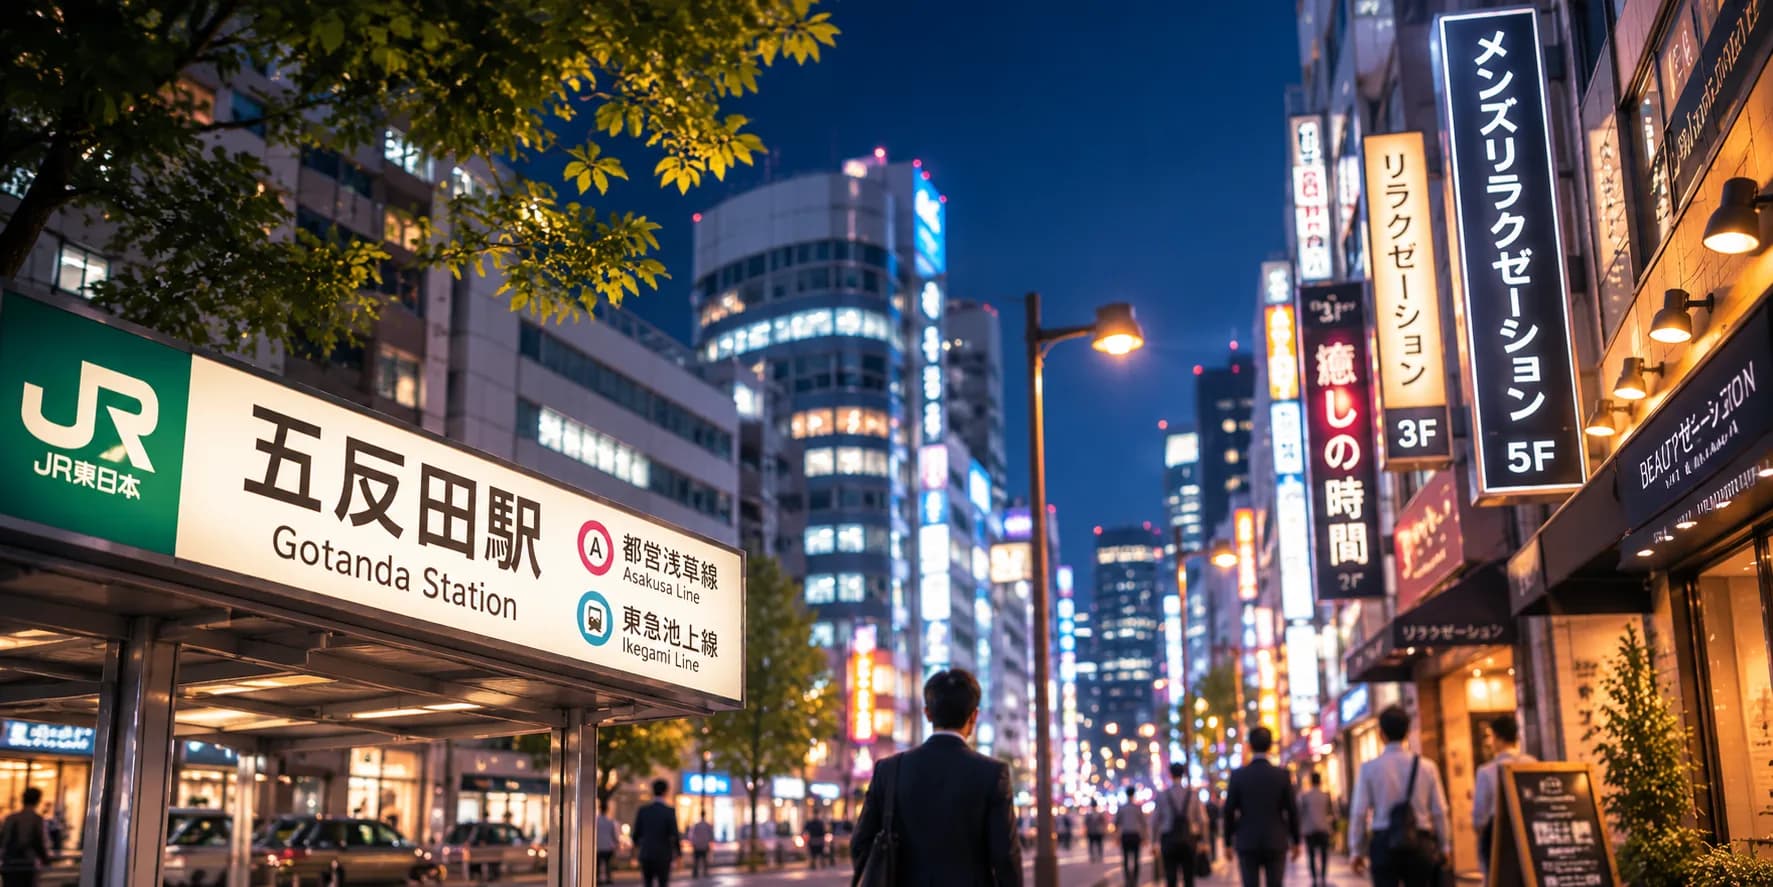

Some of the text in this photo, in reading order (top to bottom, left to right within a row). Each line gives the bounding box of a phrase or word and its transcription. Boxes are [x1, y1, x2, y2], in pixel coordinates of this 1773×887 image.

[1474, 30, 1545, 422] メンズリラクゼーション
[1383, 152, 1427, 388] リラクゼーション
[21, 360, 159, 473] JR
[1397, 418, 1437, 449] 3F
[34, 452, 141, 500] JR東日本
[1316, 341, 1369, 567] 癒しの時間
[1507, 440, 1555, 474] 5F
[243, 404, 542, 580] 五反田駅
[273, 525, 517, 621] Gotanda Station
[589, 537, 602, 559] A
[622, 533, 718, 590] 都営浅草線
[623, 567, 700, 604] Asakusa Line
[622, 605, 718, 658] 東急池上線
[622, 637, 700, 672] Ikegami Line
